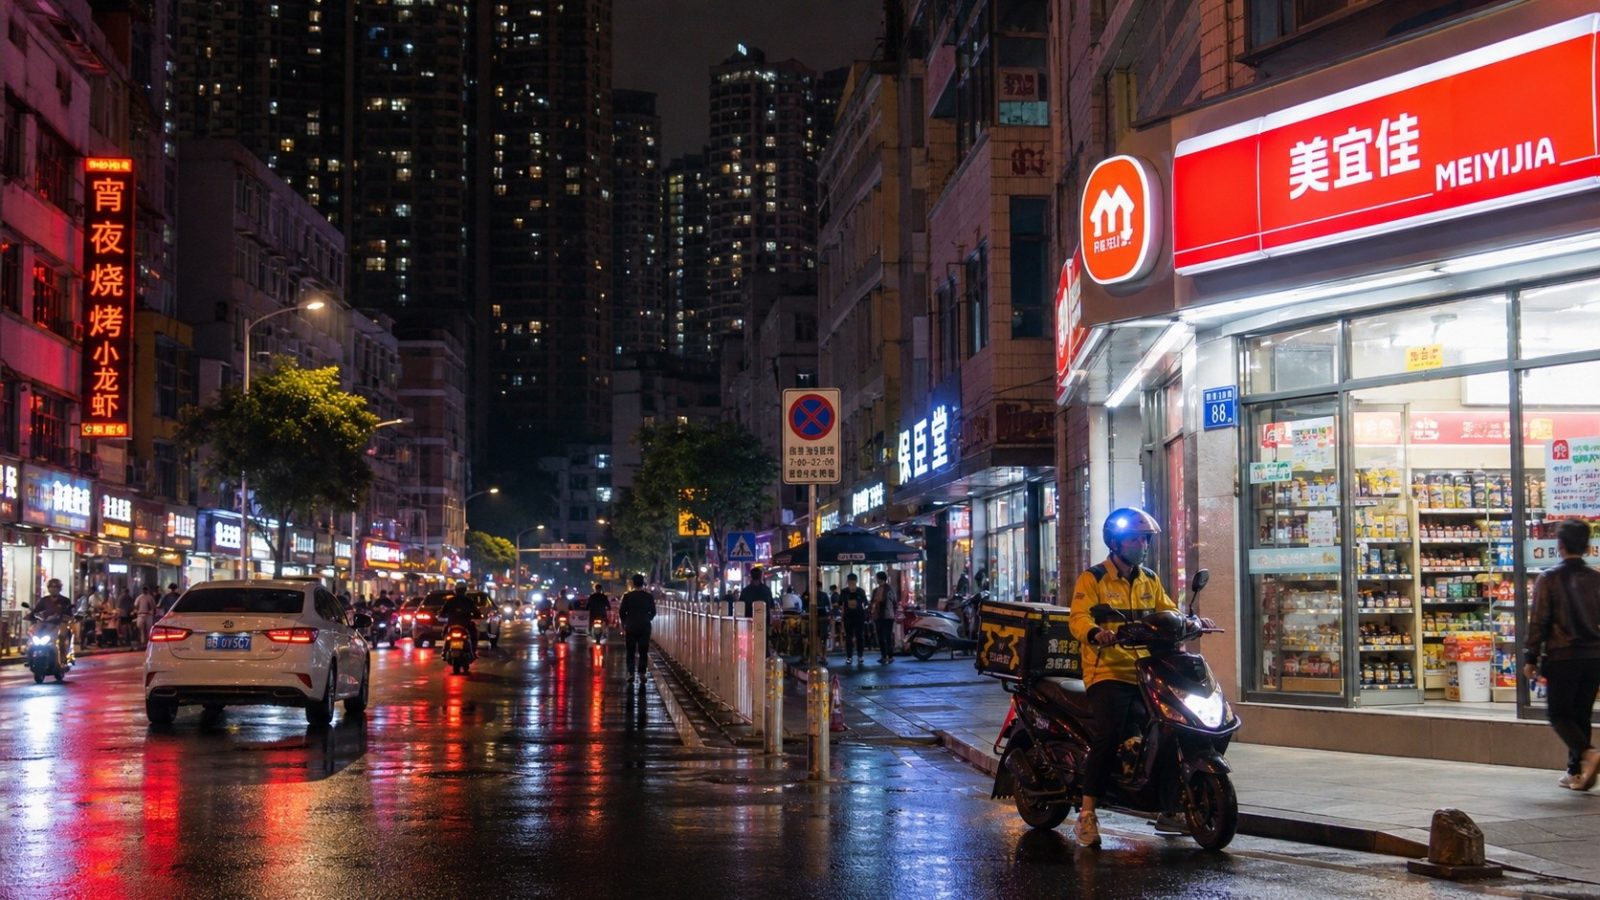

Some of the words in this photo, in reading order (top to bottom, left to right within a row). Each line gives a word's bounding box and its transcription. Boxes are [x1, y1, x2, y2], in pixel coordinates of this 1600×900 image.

[1289, 112, 1421, 200] 美宜佳
[1435, 136, 1556, 192] MEIYIJIA
[90, 178, 125, 418] 宵夜烧烤小龙虾
[1212, 403, 1225, 423] 88
